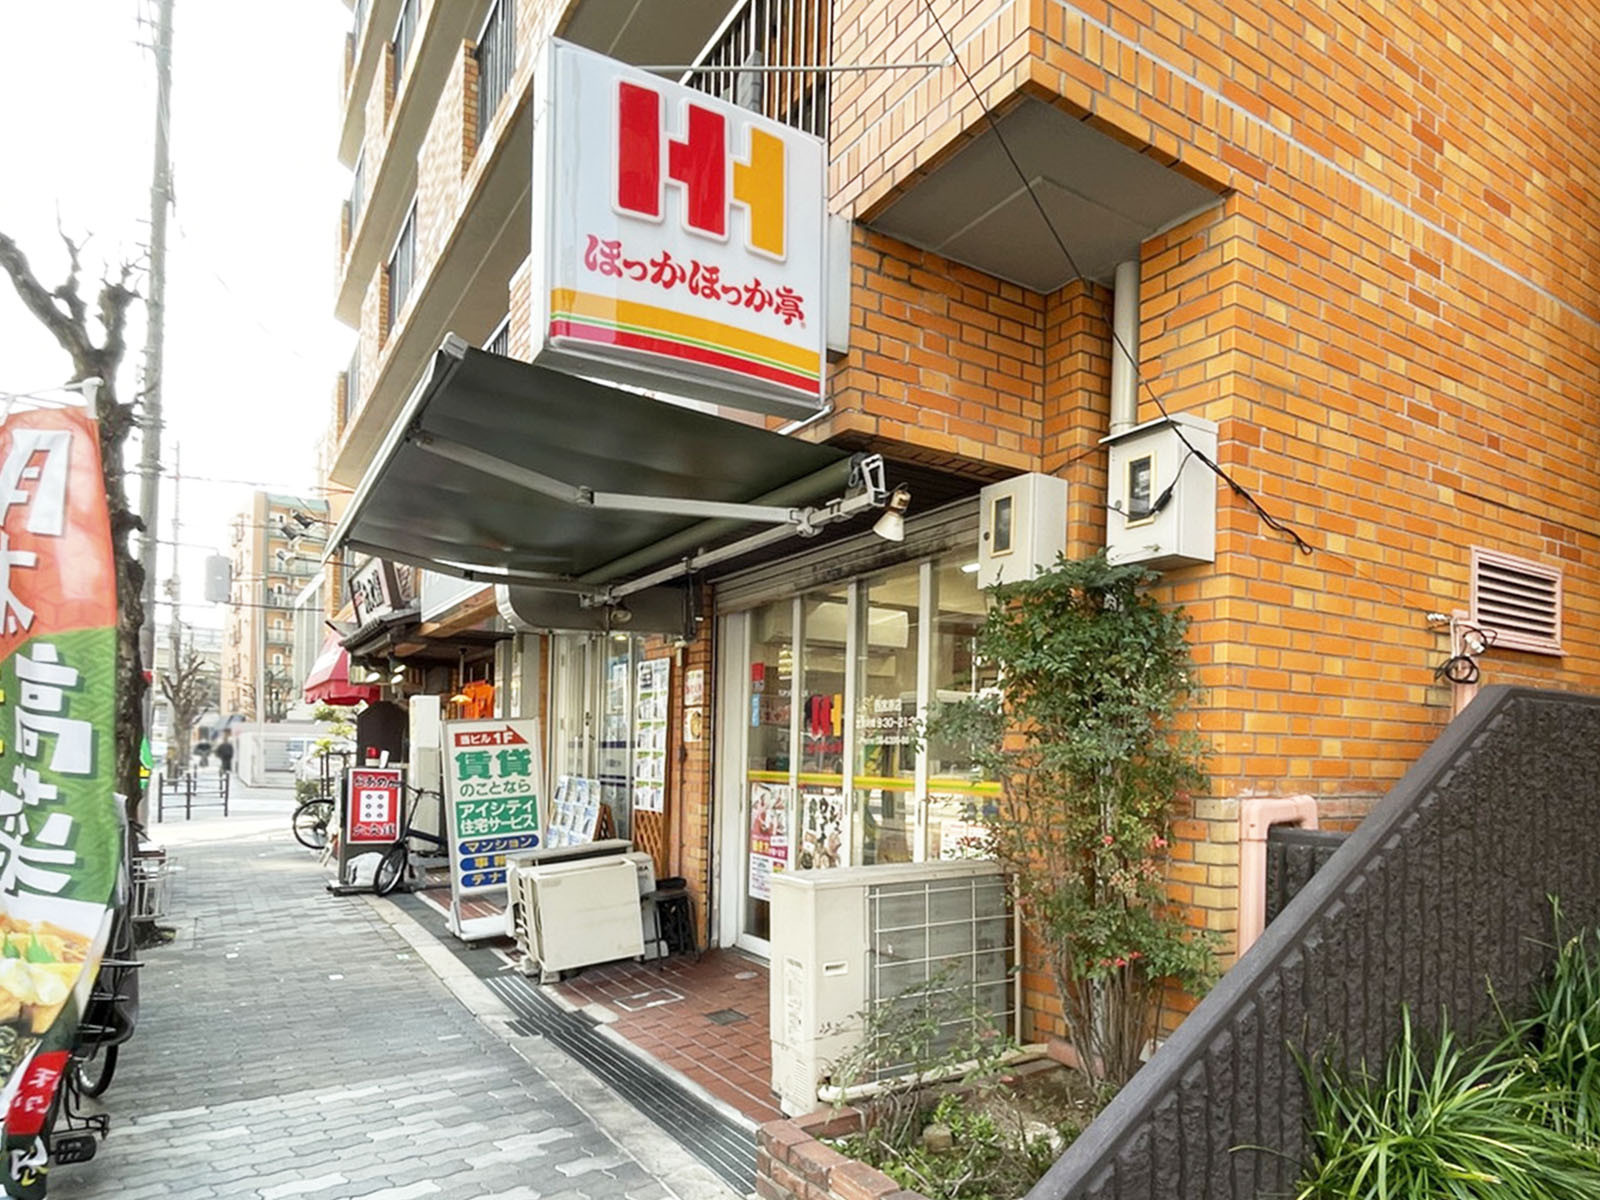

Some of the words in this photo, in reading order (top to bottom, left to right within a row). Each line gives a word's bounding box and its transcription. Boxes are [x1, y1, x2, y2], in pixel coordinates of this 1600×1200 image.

[584, 234, 804, 325] ほっかほっか亭
[493, 731, 514, 744] 1F
[454, 749, 532, 782] 賃貸
[459, 779, 531, 797] のことなら
[458, 800, 534, 818] アイシティ
[460, 814, 536, 835] 住宅サービス
[465, 837, 532, 853] マンション
